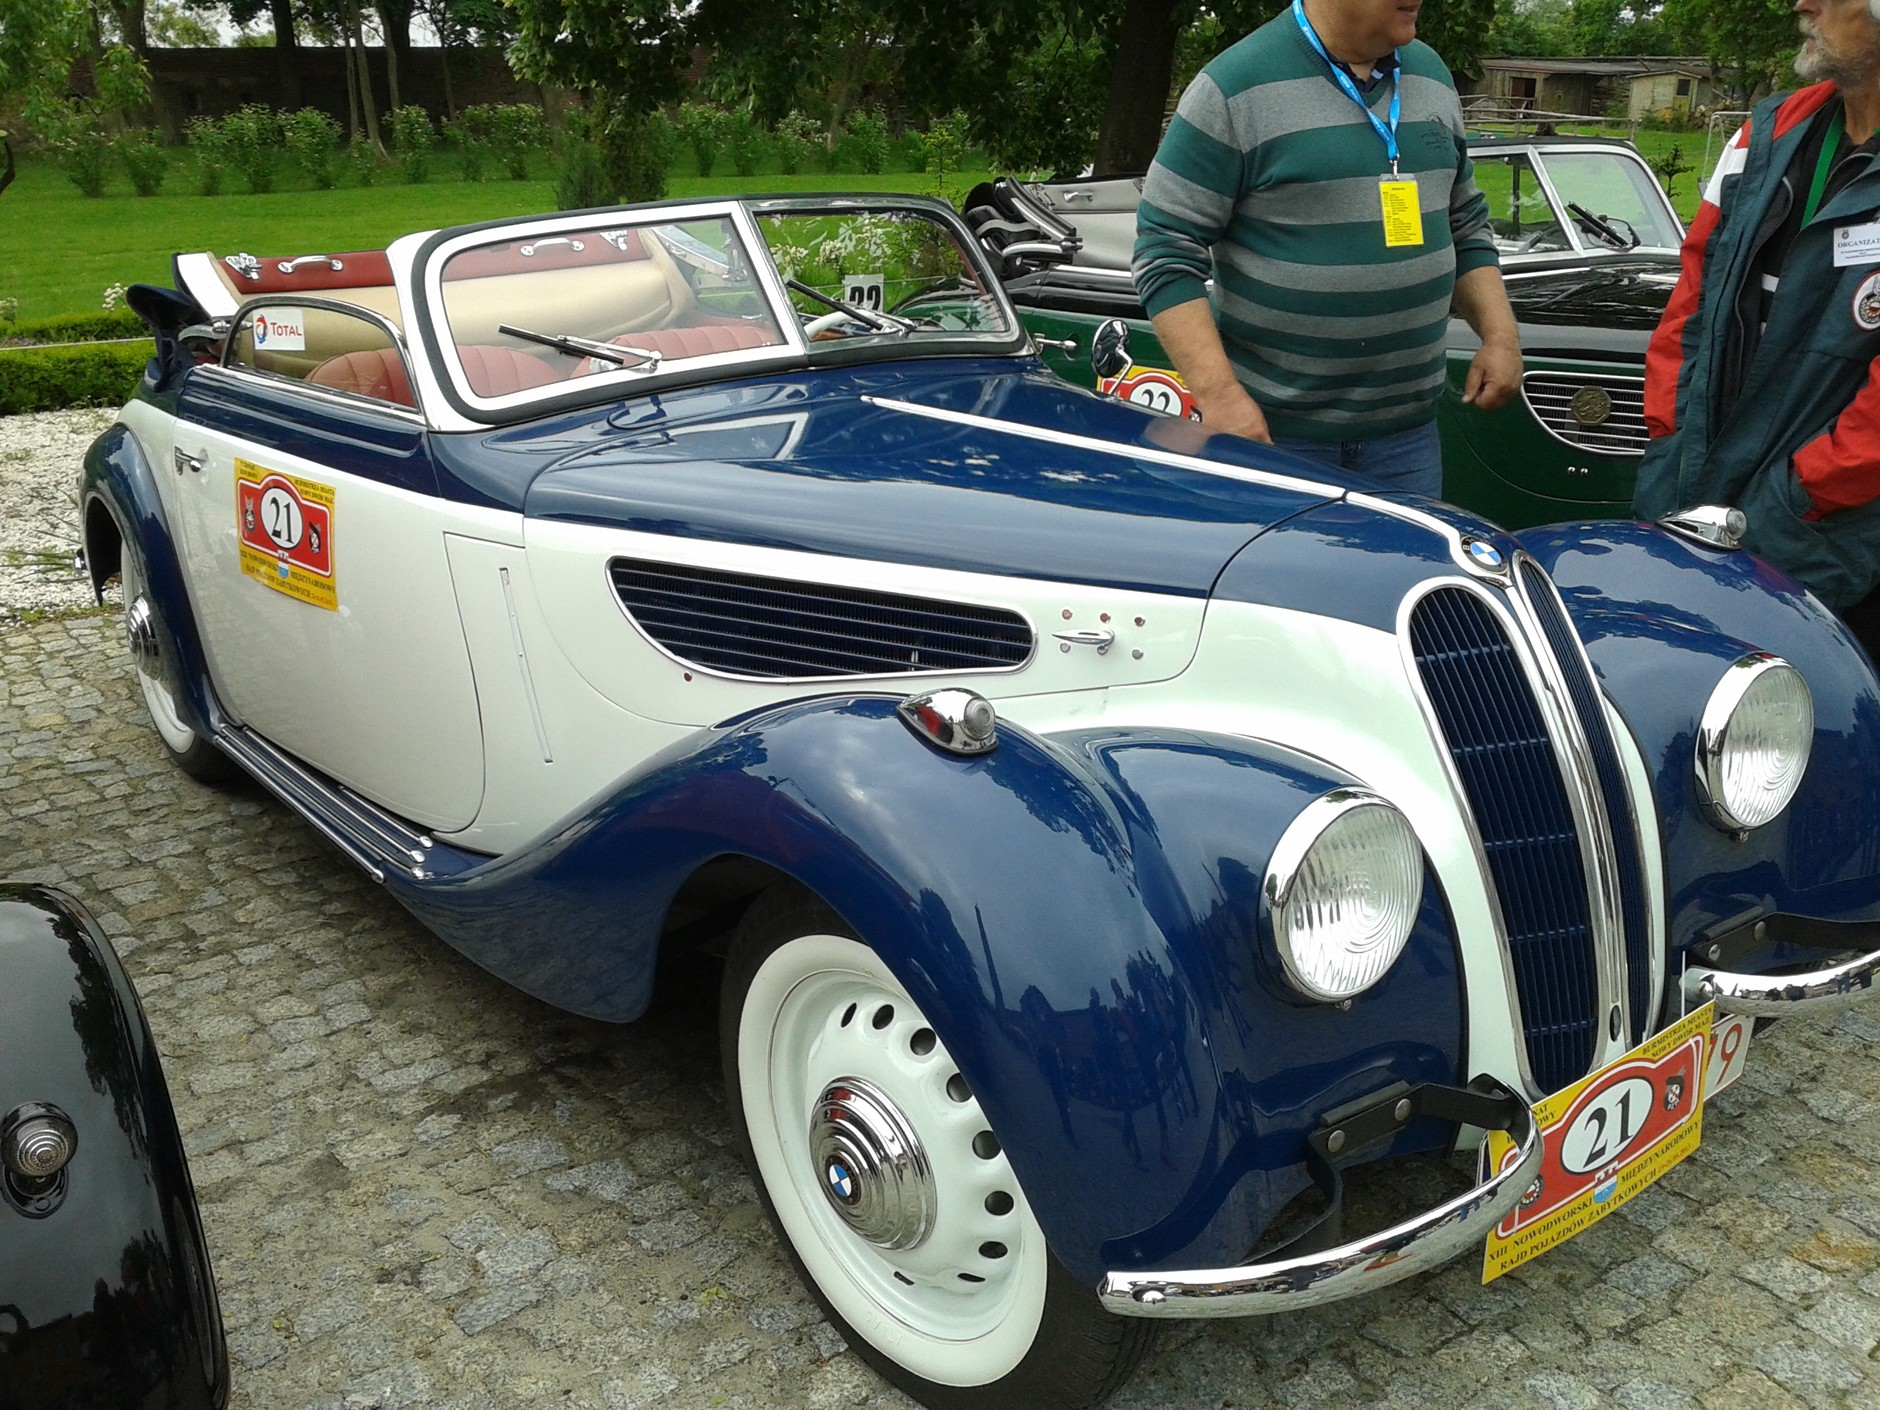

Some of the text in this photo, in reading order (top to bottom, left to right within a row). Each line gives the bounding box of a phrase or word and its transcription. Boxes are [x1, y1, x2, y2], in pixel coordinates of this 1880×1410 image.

[270, 496, 295, 544] 21
[1583, 1088, 1633, 1169] 21
[1489, 1121, 1698, 1262] XIII NOWODWORSKI MIĘDZYNARODOWY
[1500, 1251, 1528, 1271] RAJD
[1530, 1216, 1586, 1255] POJAZDÓW
[1588, 1168, 1657, 1222] ZABYTKOWYCH
